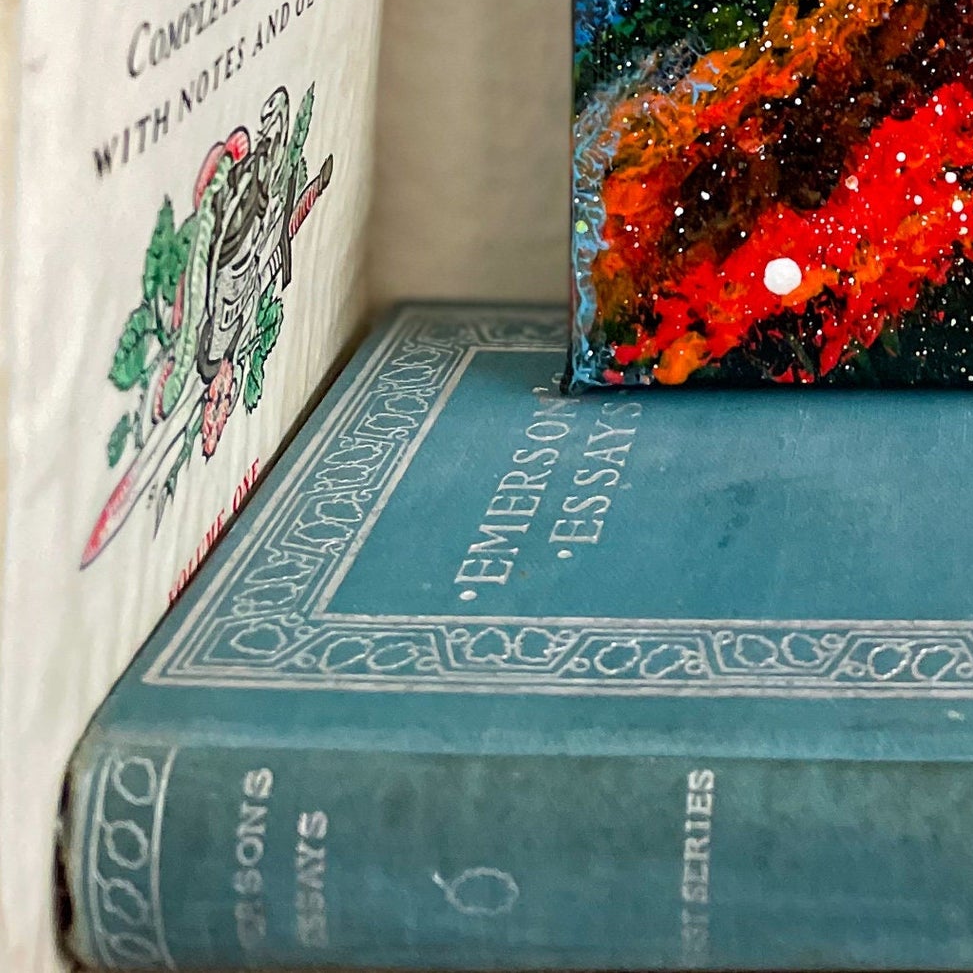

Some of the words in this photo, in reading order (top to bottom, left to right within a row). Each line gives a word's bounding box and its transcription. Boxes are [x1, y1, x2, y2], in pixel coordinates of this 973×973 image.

[92, 99, 171, 180] WITH
[177, 36, 246, 123] NOTES
[252, 1, 290, 57] AND
[681, 768, 715, 904] SERIES
